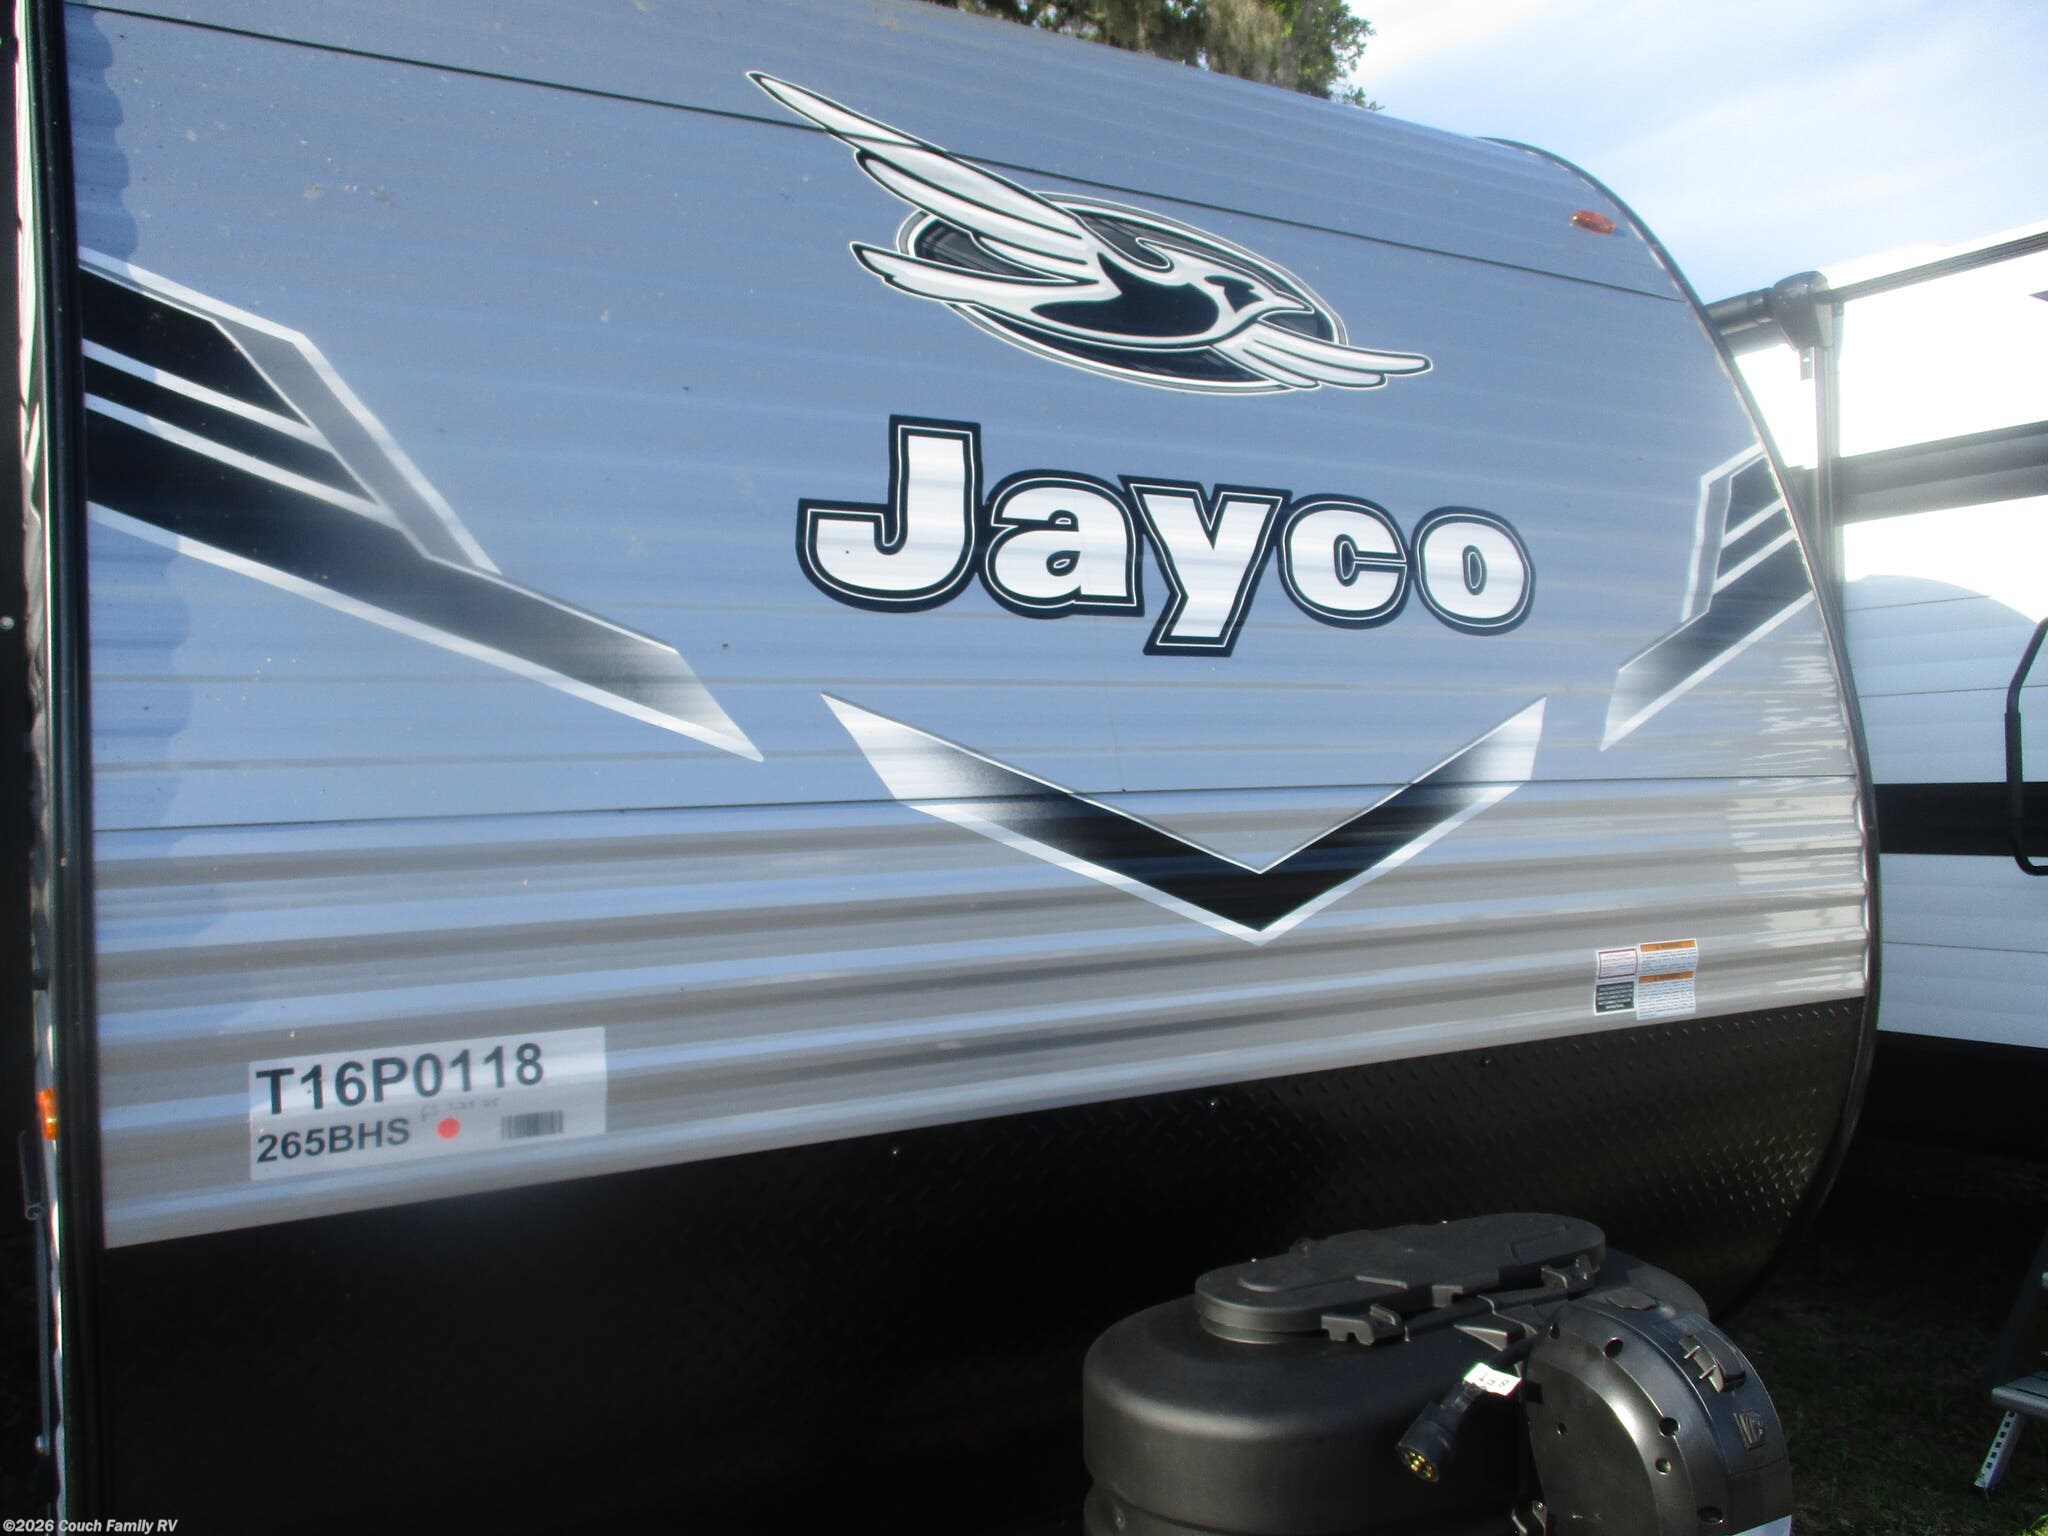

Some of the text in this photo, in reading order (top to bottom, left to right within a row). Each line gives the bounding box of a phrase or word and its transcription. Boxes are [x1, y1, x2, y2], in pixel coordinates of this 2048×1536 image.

[797, 415, 1536, 656] Jayco
[255, 1042, 544, 1115] T16P0118
[256, 1117, 411, 1163] 265BHS
